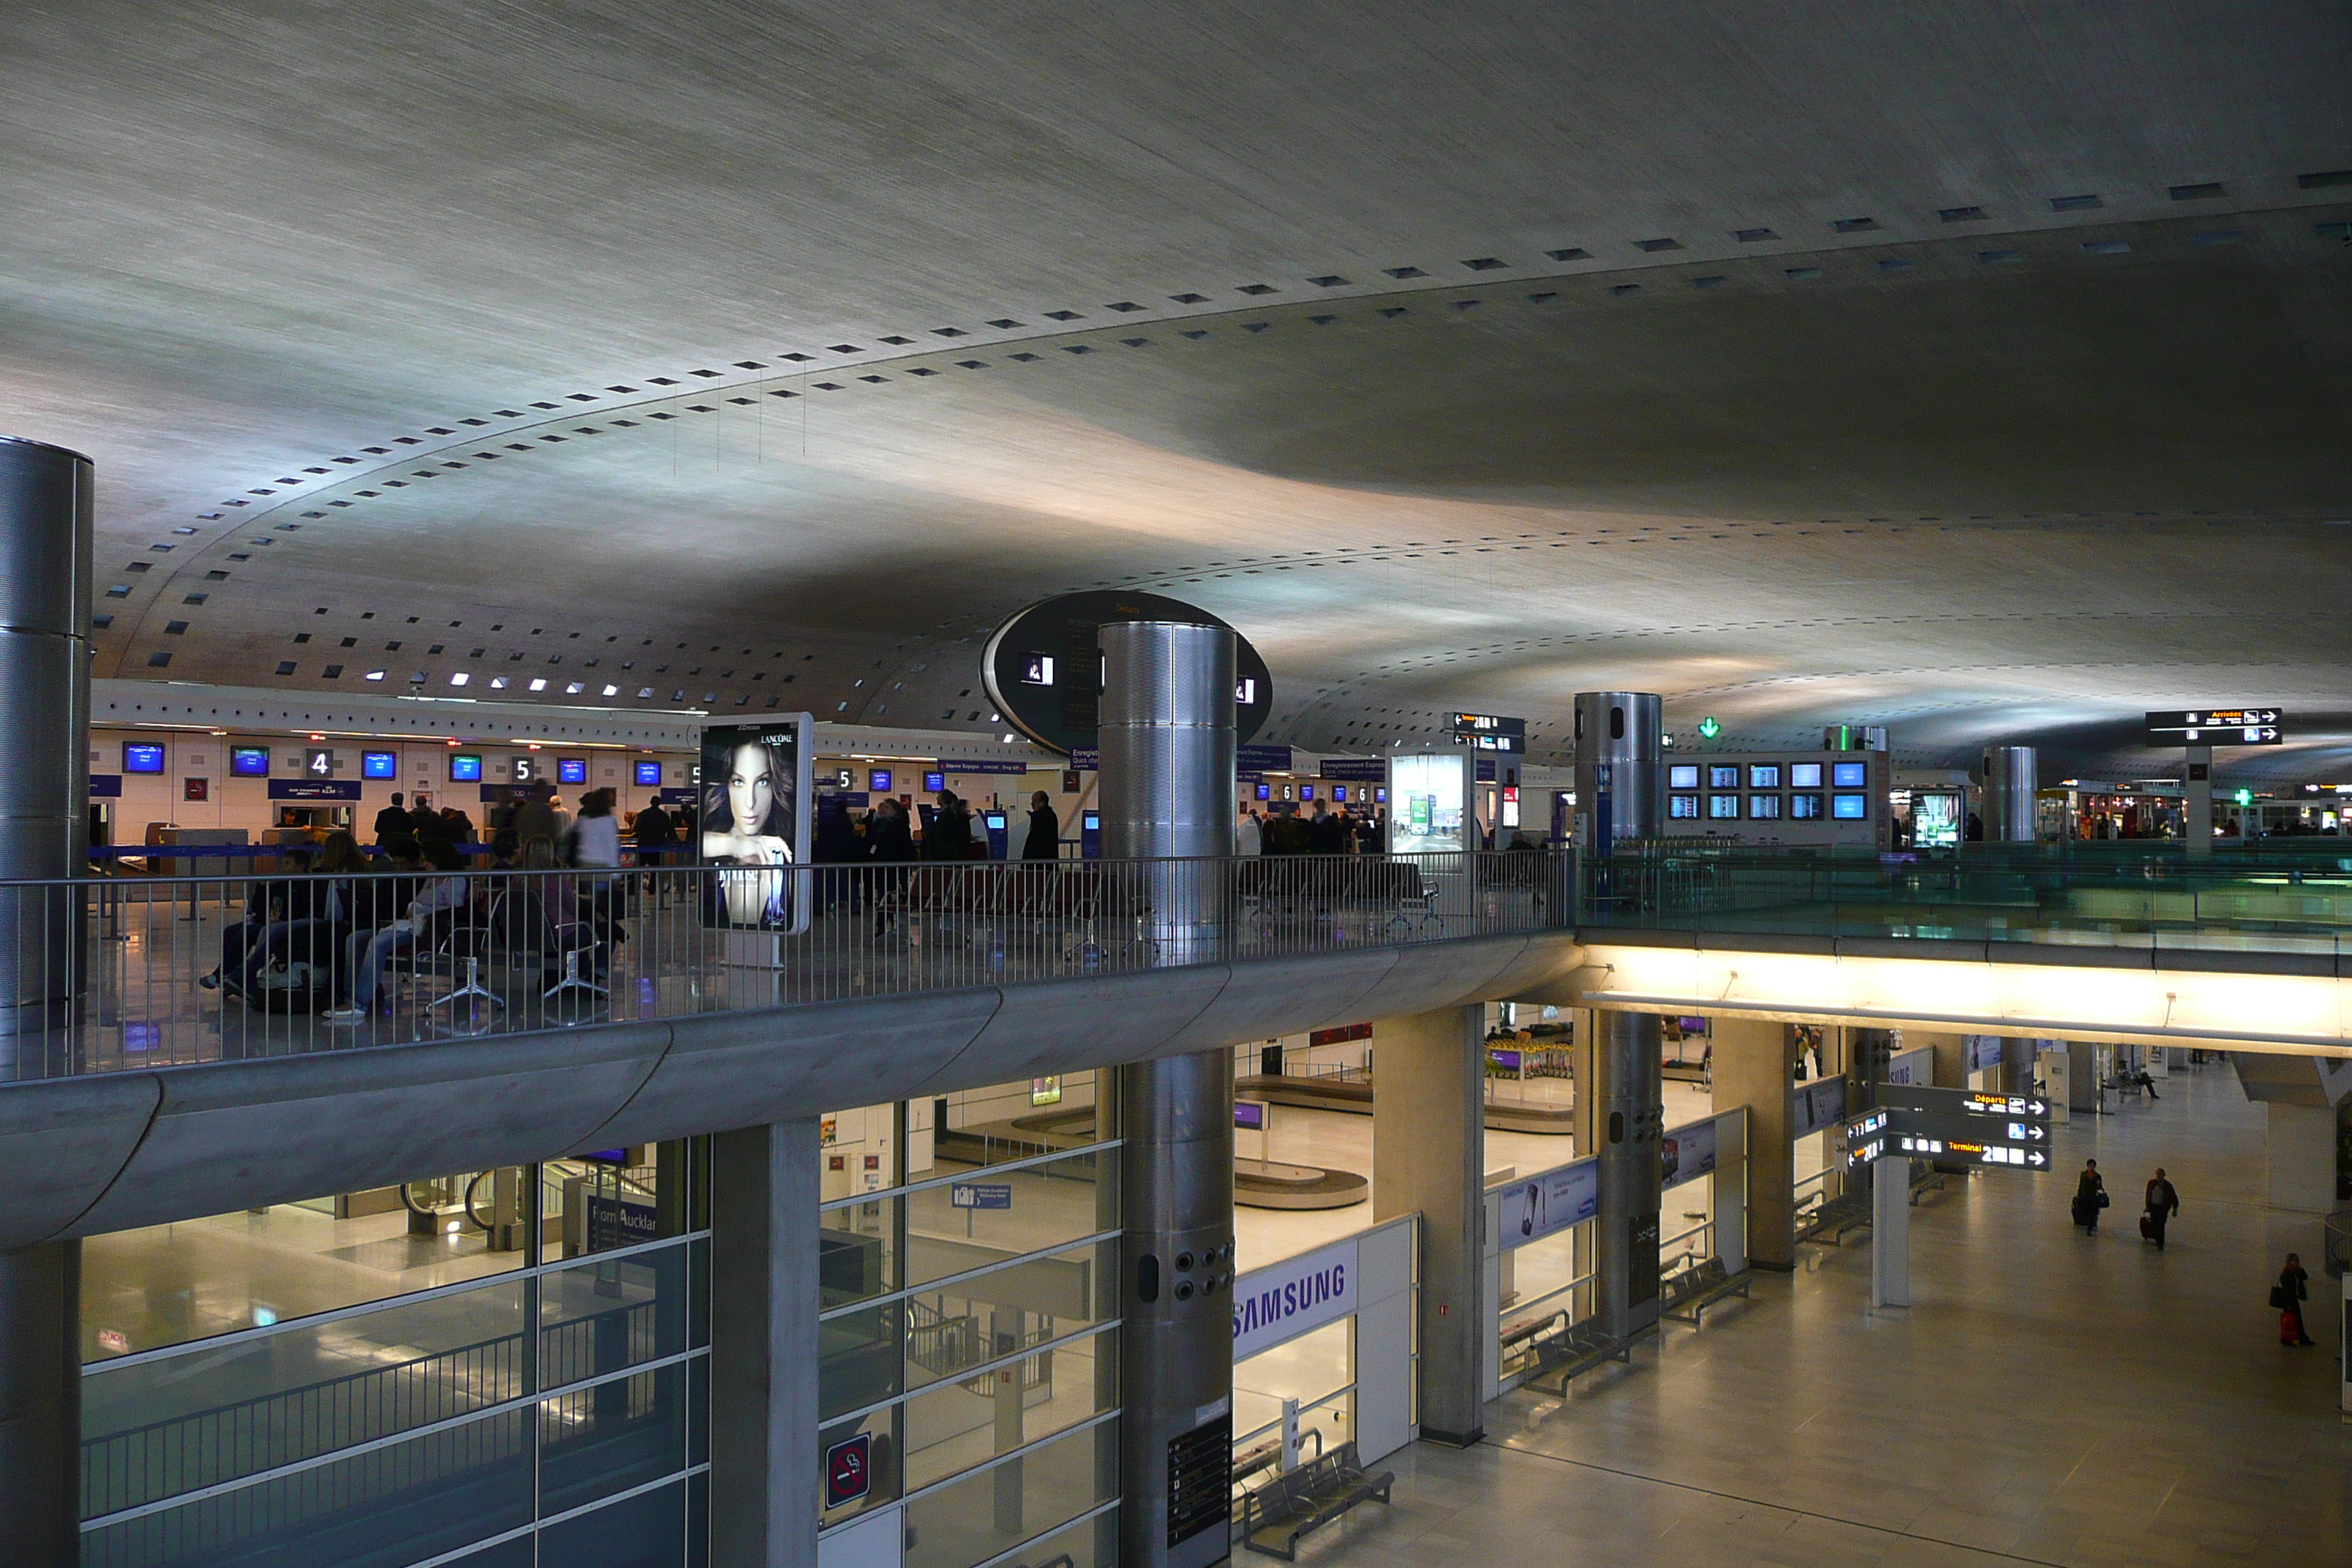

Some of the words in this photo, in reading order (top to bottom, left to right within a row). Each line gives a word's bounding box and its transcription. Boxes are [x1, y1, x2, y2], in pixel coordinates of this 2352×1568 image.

[1116, 603, 1140, 614] Départs
[761, 734, 793, 744] LANCÔME
[312, 753, 328, 774] 4
[517, 761, 529, 779] 5
[840, 771, 849, 788] 5
[1284, 785, 1290, 799] 6
[1360, 788, 1365, 801] 6
[1975, 1094, 2006, 1104] Départs
[1948, 1141, 1982, 1153] Terminal
[1982, 1145, 1993, 1162] 2
